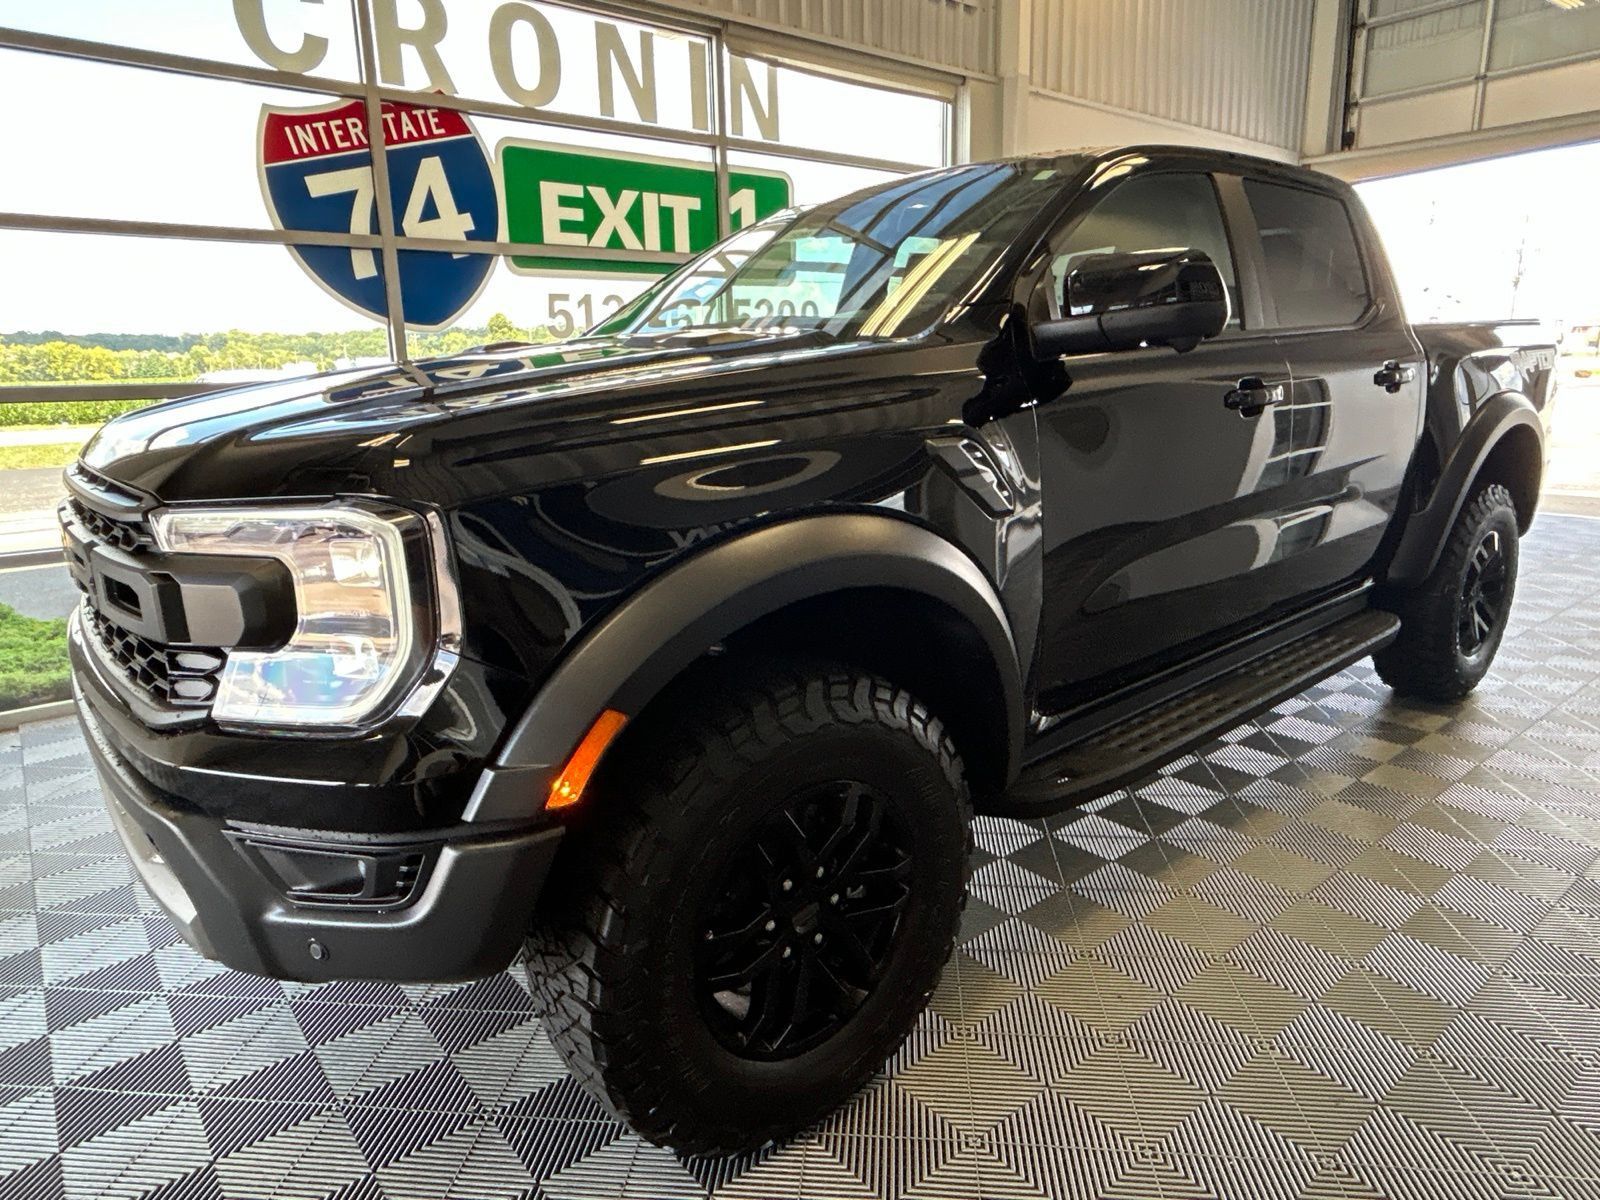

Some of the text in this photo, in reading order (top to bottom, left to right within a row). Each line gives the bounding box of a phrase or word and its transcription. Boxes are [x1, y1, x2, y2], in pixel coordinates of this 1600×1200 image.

[232, 0, 780, 142] CRONIN
[284, 108, 446, 156] INTERTATE
[303, 155, 476, 281] 74
[539, 180, 702, 254] EXIT
